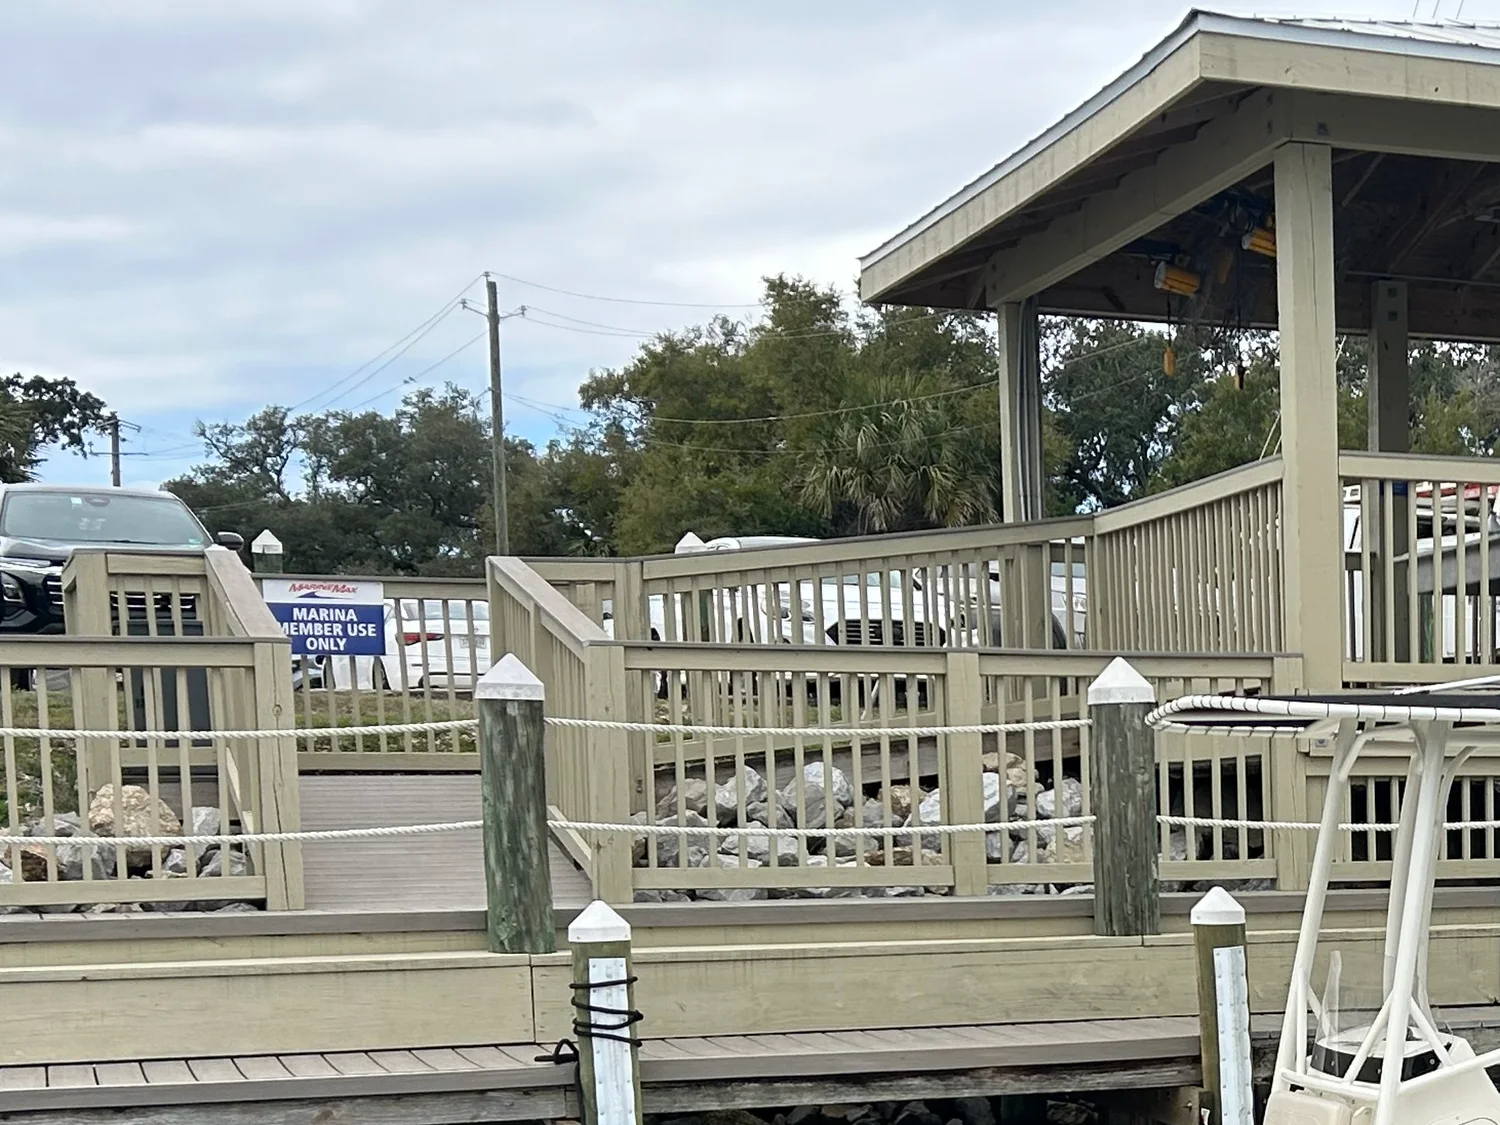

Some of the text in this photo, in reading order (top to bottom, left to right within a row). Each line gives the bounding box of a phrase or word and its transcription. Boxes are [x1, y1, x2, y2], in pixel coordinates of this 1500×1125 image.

[292, 607, 358, 622] MARINA
[346, 623, 377, 637] USE
[305, 637, 347, 651] ONLY
